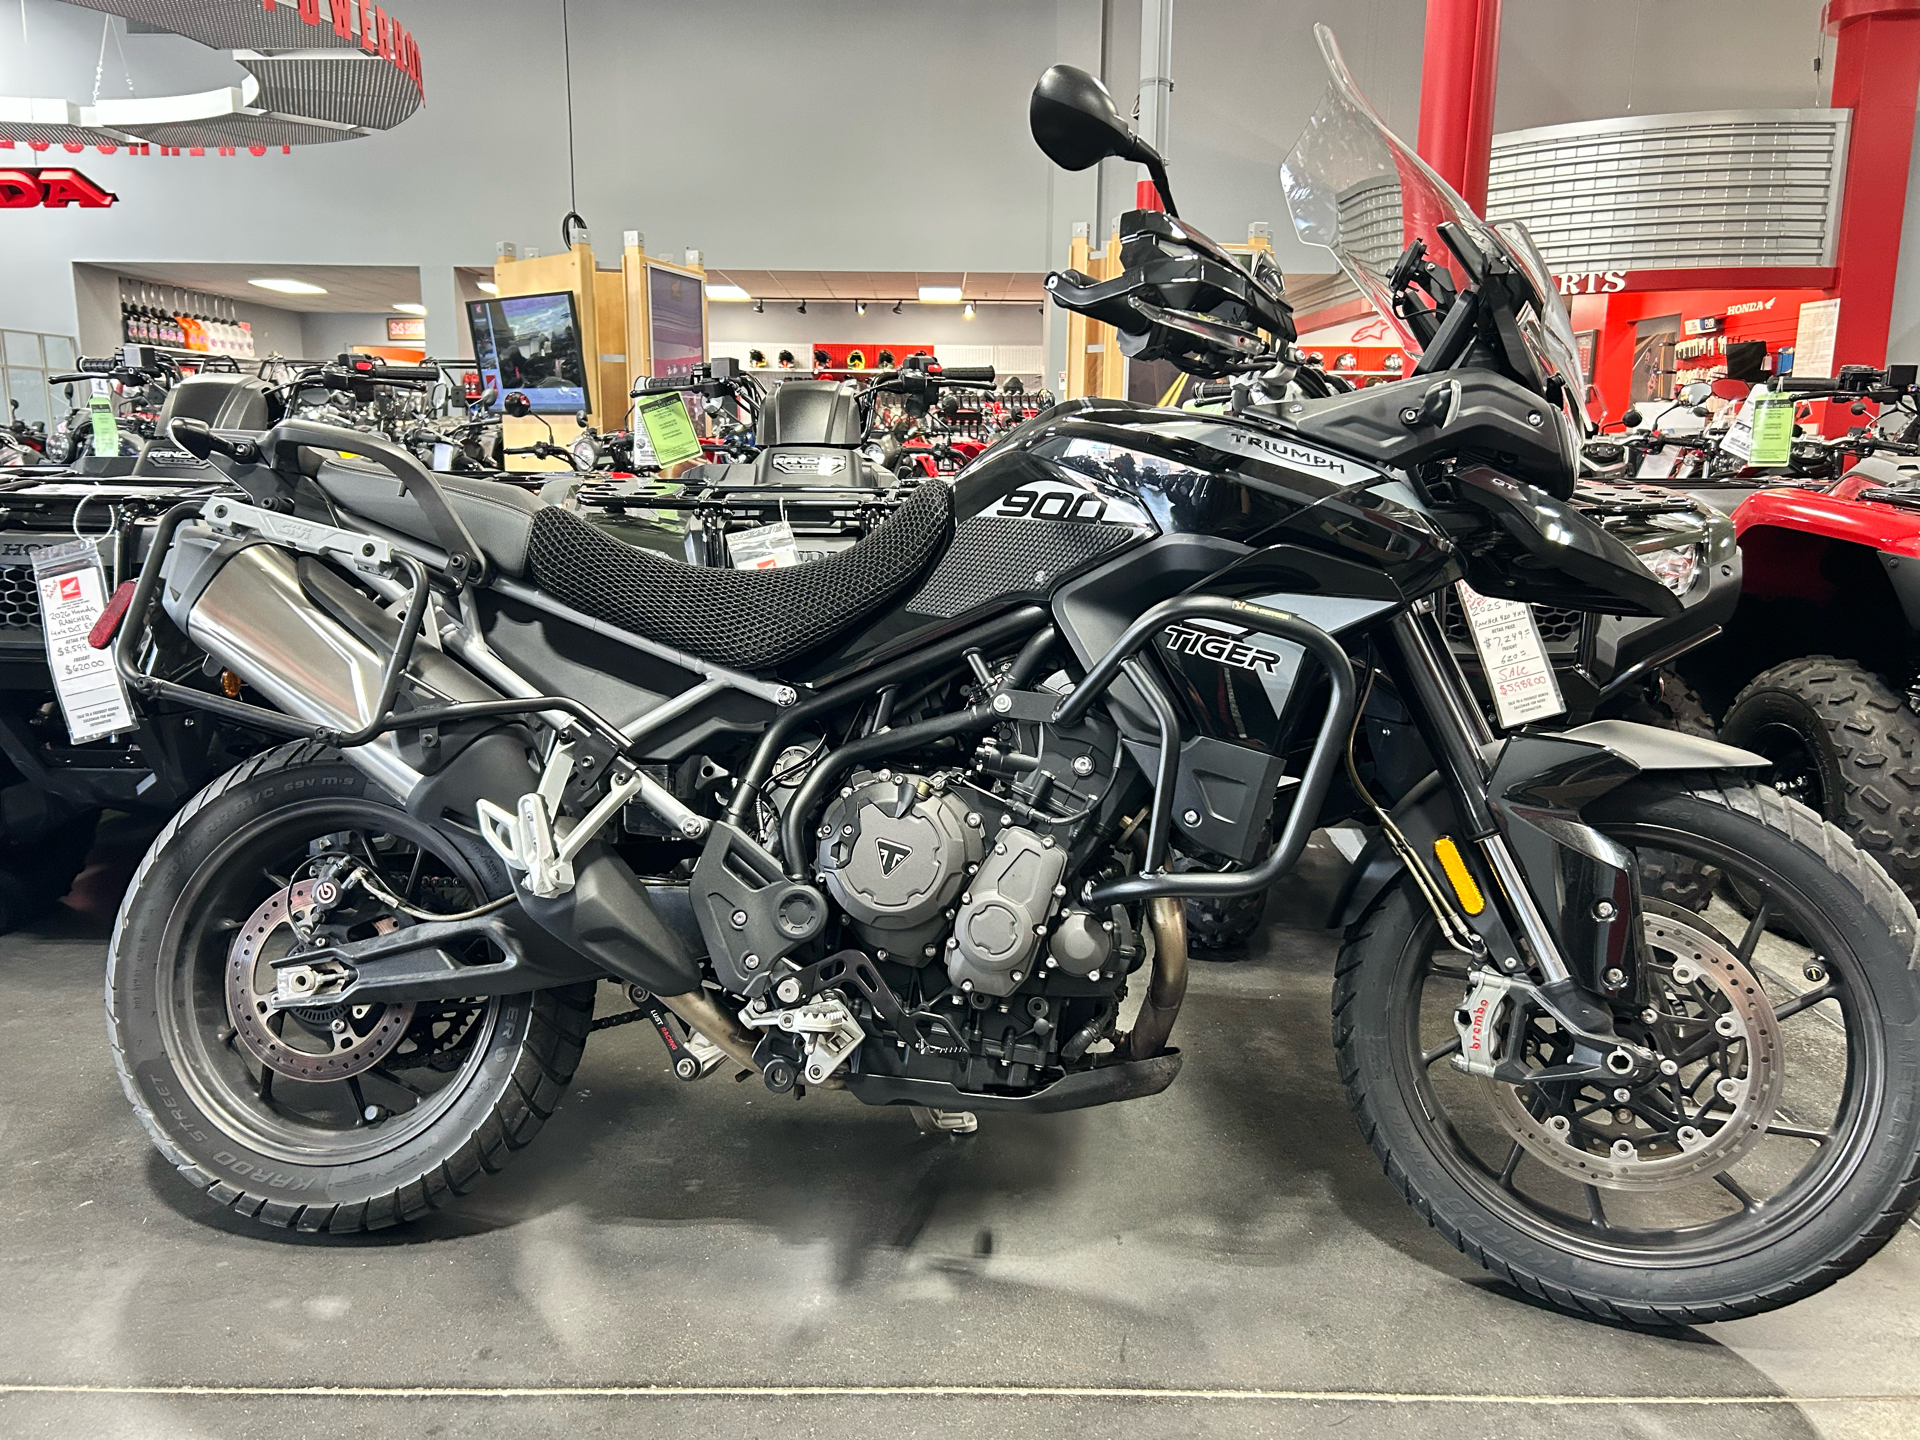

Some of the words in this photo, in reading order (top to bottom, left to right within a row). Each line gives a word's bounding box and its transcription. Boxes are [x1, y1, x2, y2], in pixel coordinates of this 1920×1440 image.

[1558, 270, 1628, 295] RTS
[1726, 300, 1764, 316] HONDA
[147, 451, 194, 459] RANC
[1231, 433, 1345, 474] TRIUMPH
[1492, 478, 1519, 490] GT
[997, 490, 1110, 525] 900
[279, 522, 313, 540] GIVI
[49, 610, 72, 621] 2026
[72, 605, 99, 616] Honda
[1471, 601, 1501, 617] 2025
[58, 615, 93, 627] RANCHER
[1491, 626, 1504, 634] RETAIL
[1504, 623, 1516, 631] PRICE
[1164, 625, 1283, 676] TIGER
[65, 660, 105, 675] $620.00
[650, 1009, 664, 1026] LUST
[660, 1026, 678, 1051] RACING
[1469, 999, 1489, 1050] brembo
[149, 1074, 208, 1143] STREET
[212, 1151, 317, 1192] KAROO
